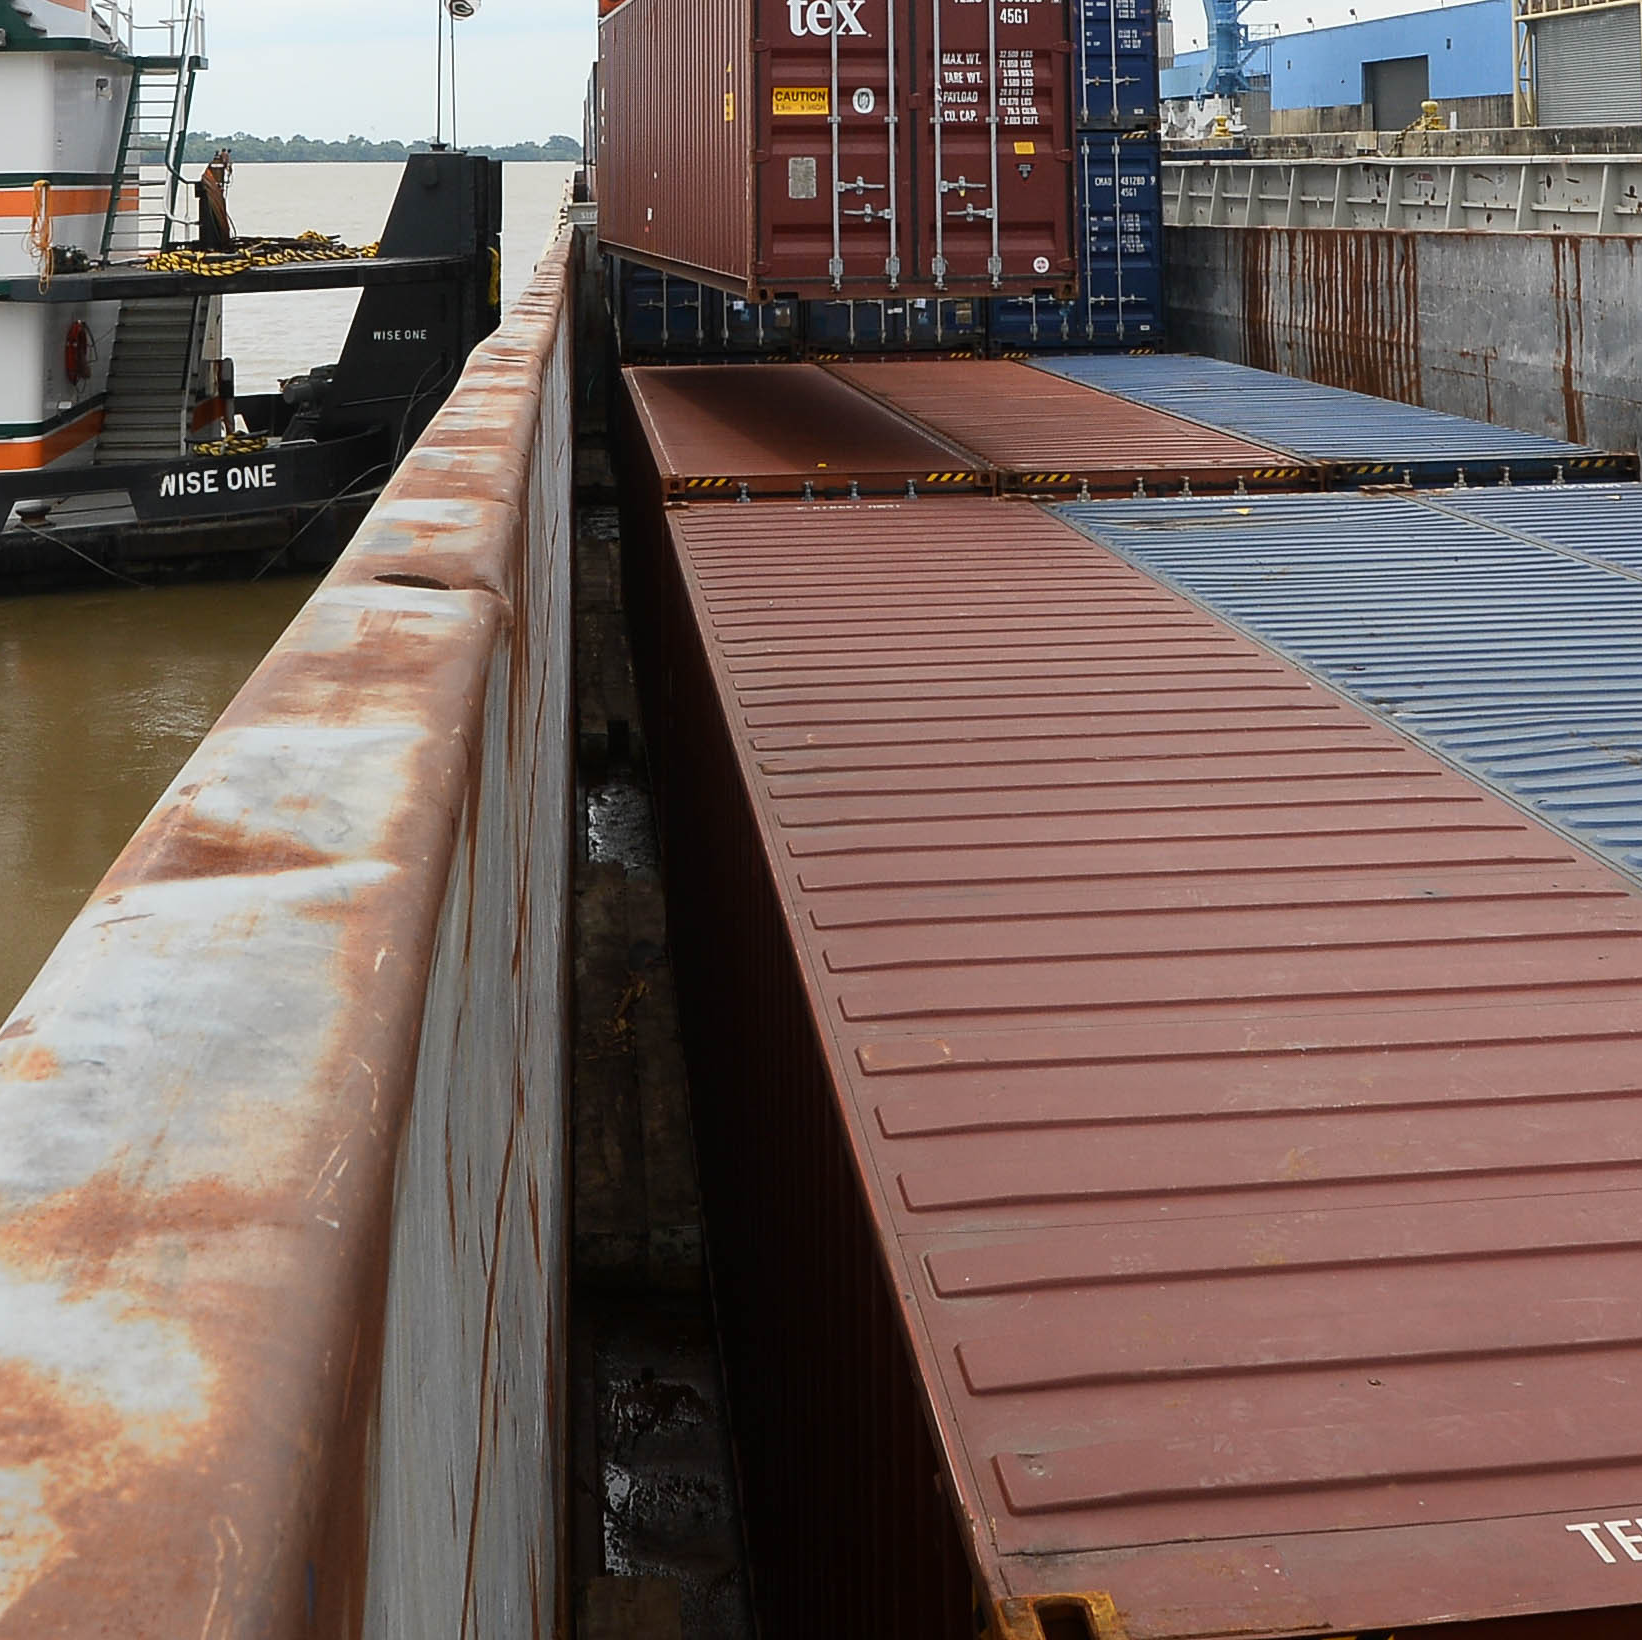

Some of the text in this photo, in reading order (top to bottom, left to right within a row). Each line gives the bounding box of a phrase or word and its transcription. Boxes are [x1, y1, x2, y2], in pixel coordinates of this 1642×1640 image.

[999, 8, 1029, 24] 45G1
[943, 71, 963, 84] TARE
[775, 91, 826, 102] CAUTION
[943, 91, 978, 103] PAYLOAD
[959, 109, 978, 122] CAP.
[373, 329, 427, 341] WISE ONE
[226, 463, 277, 490] ONE
